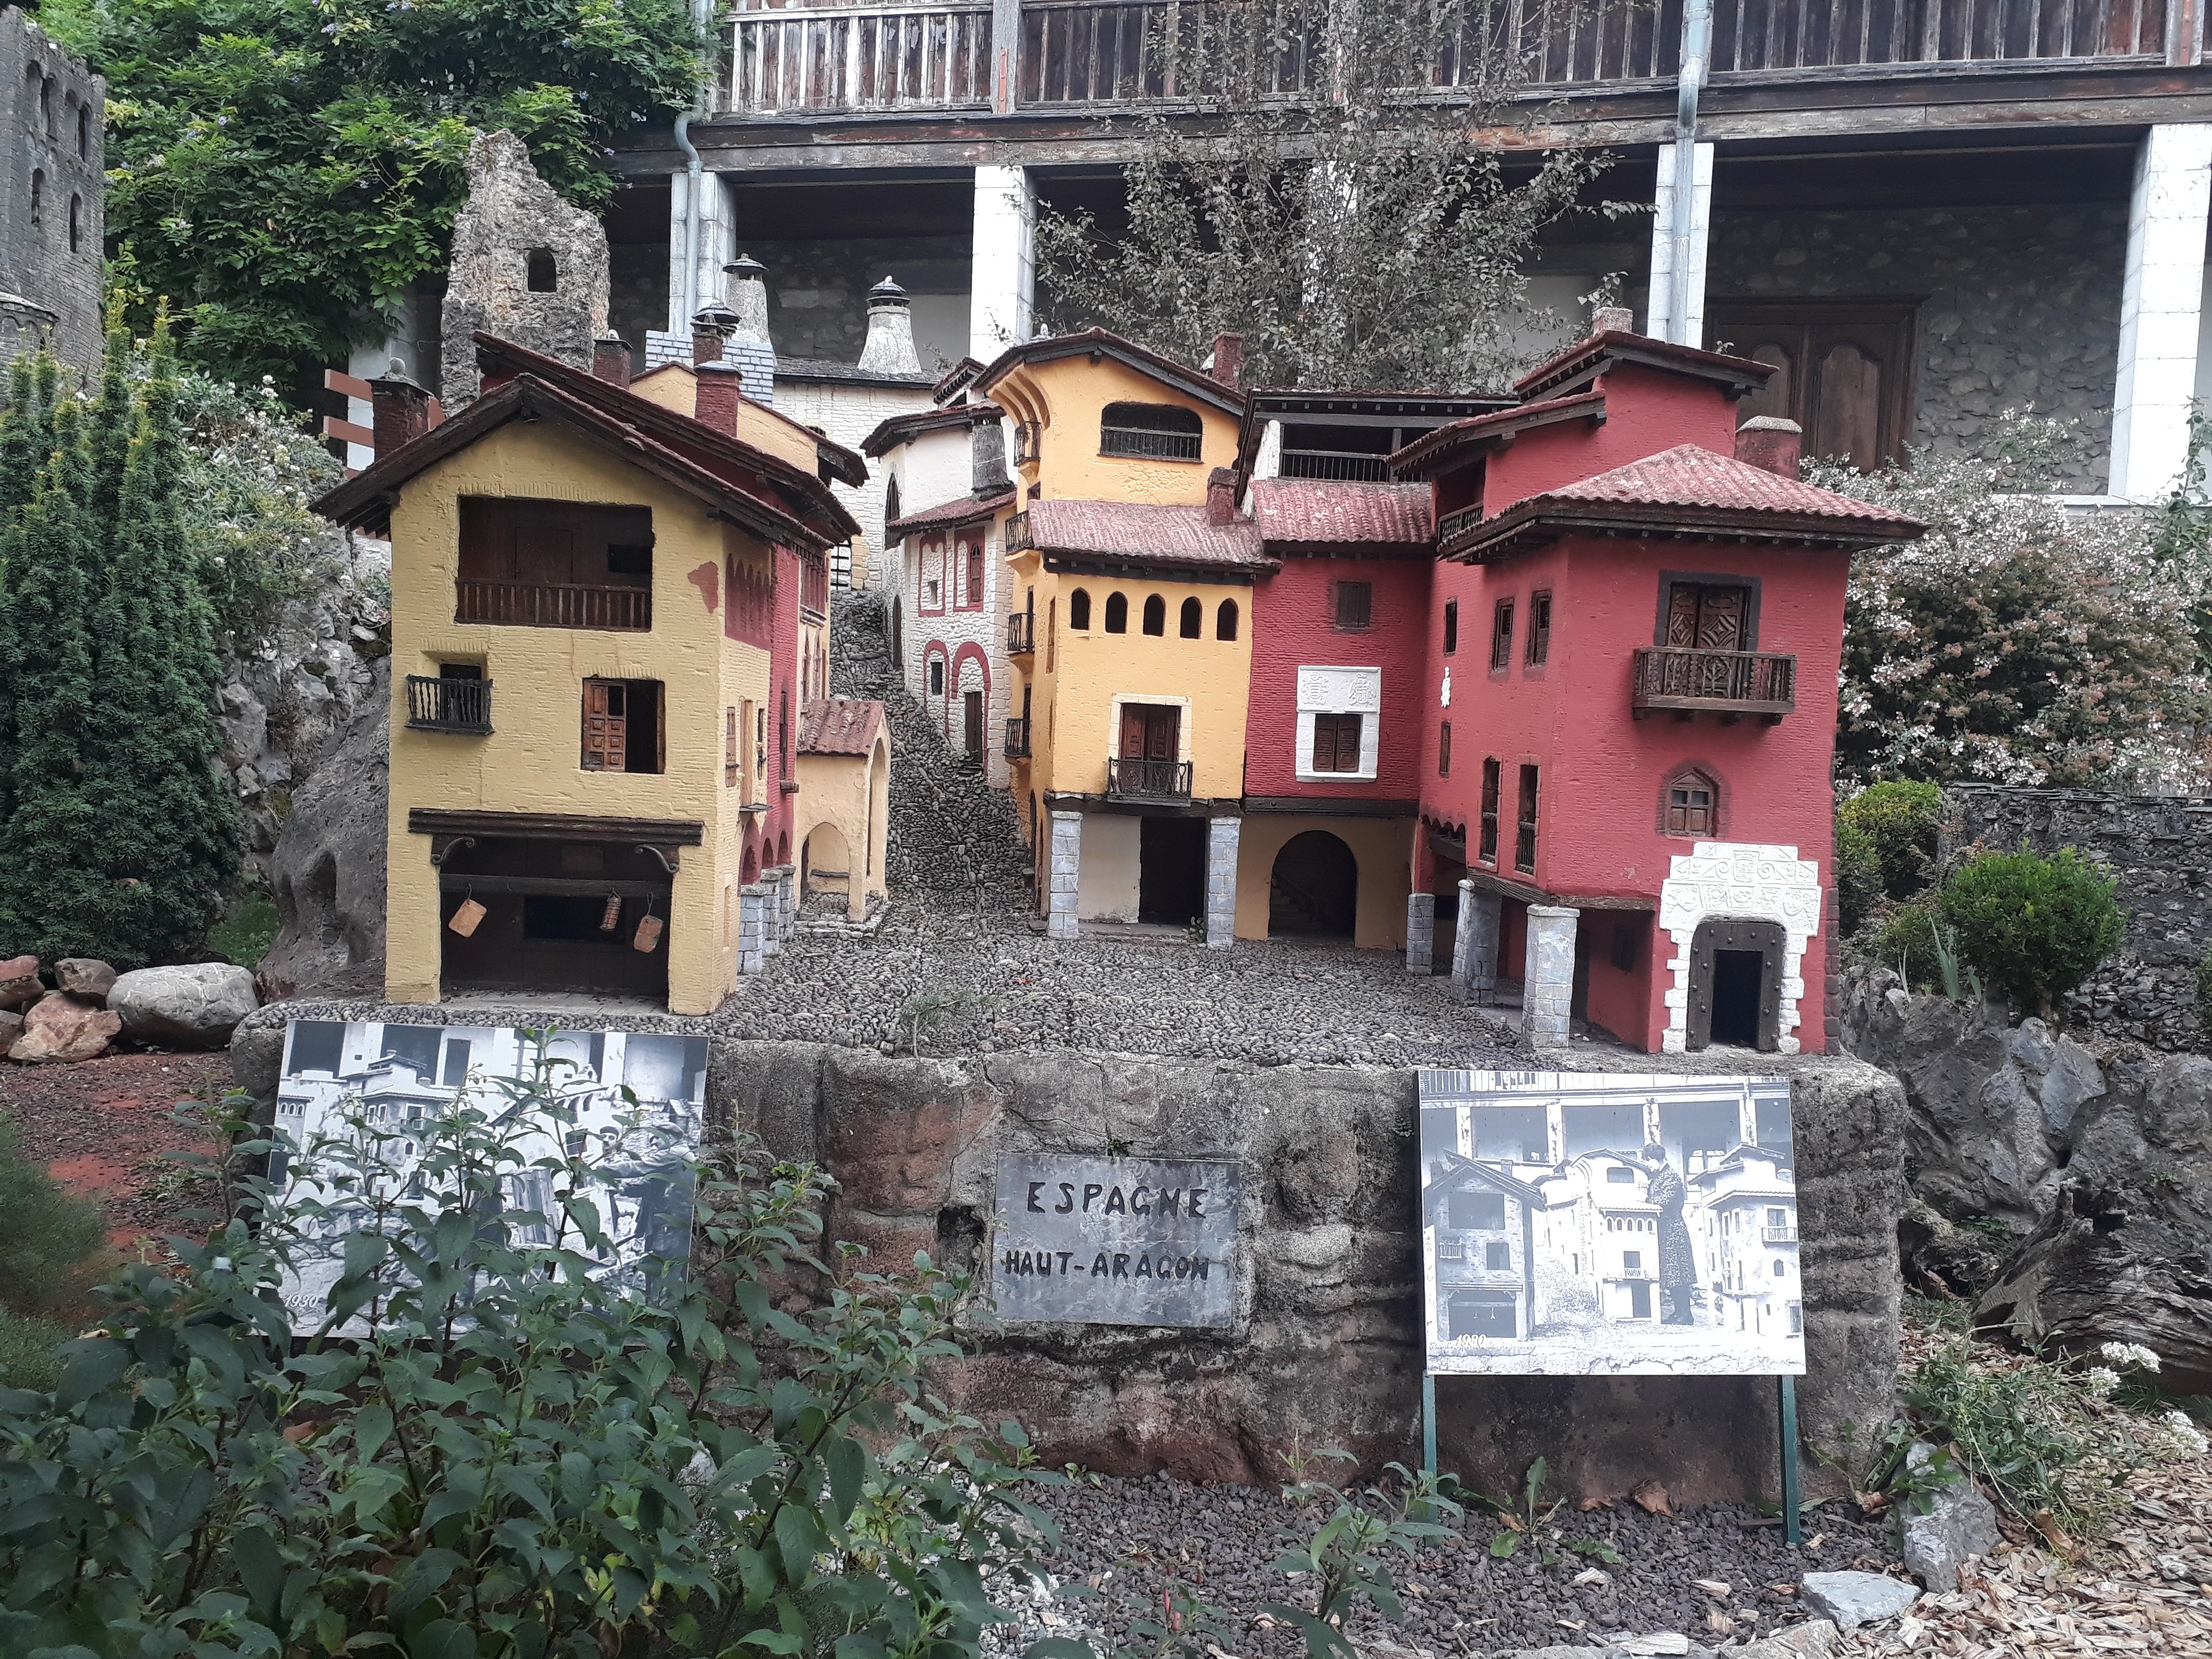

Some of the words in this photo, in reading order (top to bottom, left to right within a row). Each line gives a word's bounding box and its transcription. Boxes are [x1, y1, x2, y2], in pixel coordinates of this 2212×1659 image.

[1027, 1182, 1208, 1219] ESPAGNE
[1005, 1250, 1208, 1281] HAUT-ARAGON
[284, 1294, 318, 1308] 1930
